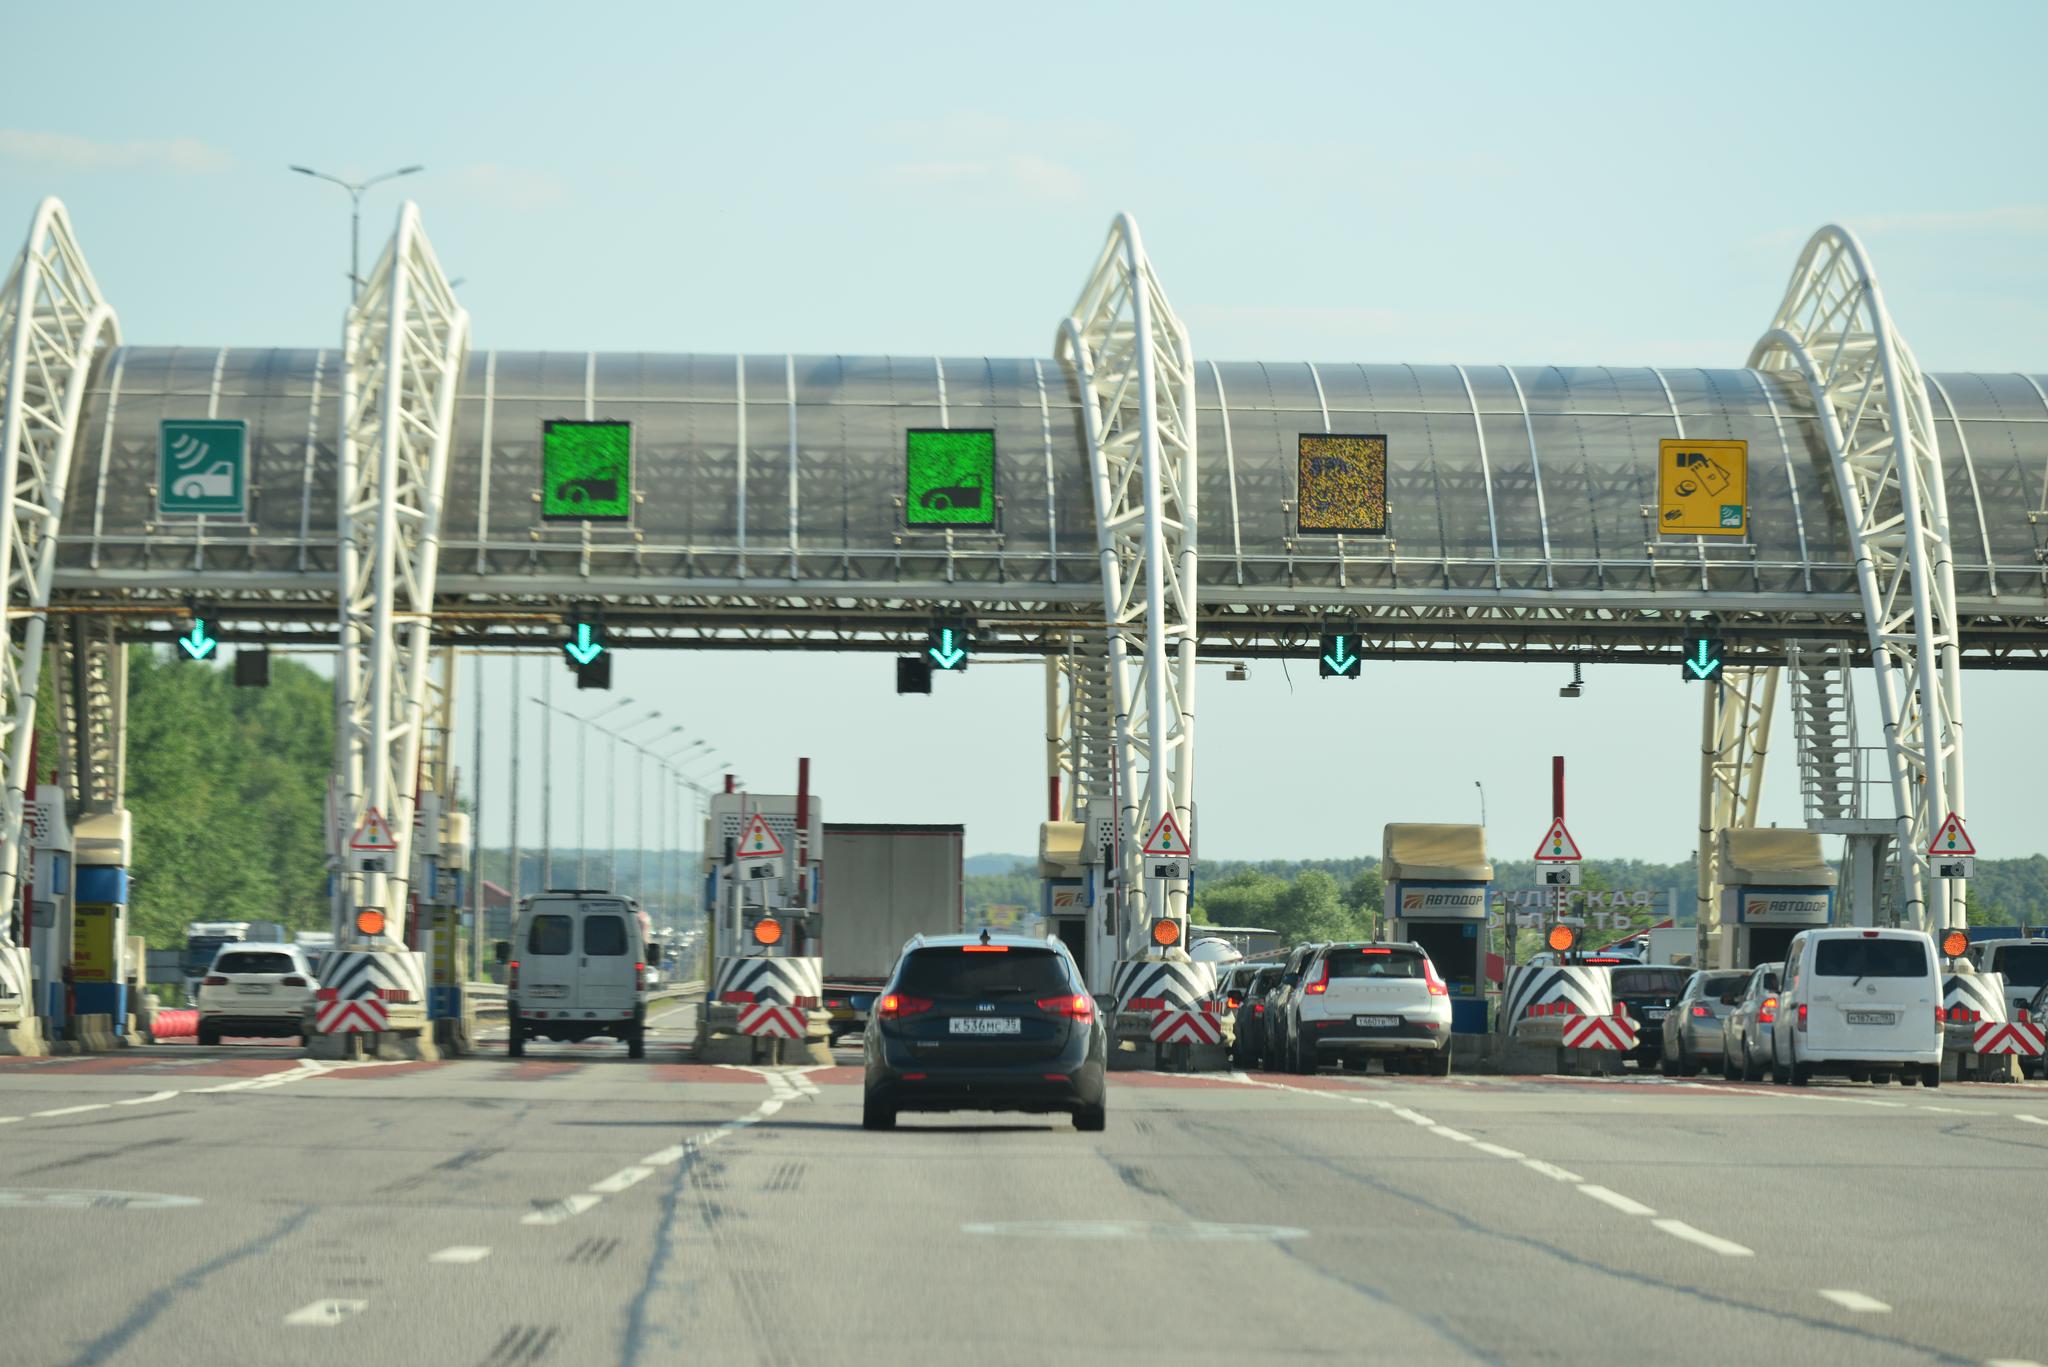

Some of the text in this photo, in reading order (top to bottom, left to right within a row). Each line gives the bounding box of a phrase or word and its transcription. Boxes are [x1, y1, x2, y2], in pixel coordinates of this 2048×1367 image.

[1425, 894, 1483, 906] АВТОДОР
[1769, 900, 1827, 912] АВТОДОР
[1485, 911, 1631, 930] ОЛТЬ
